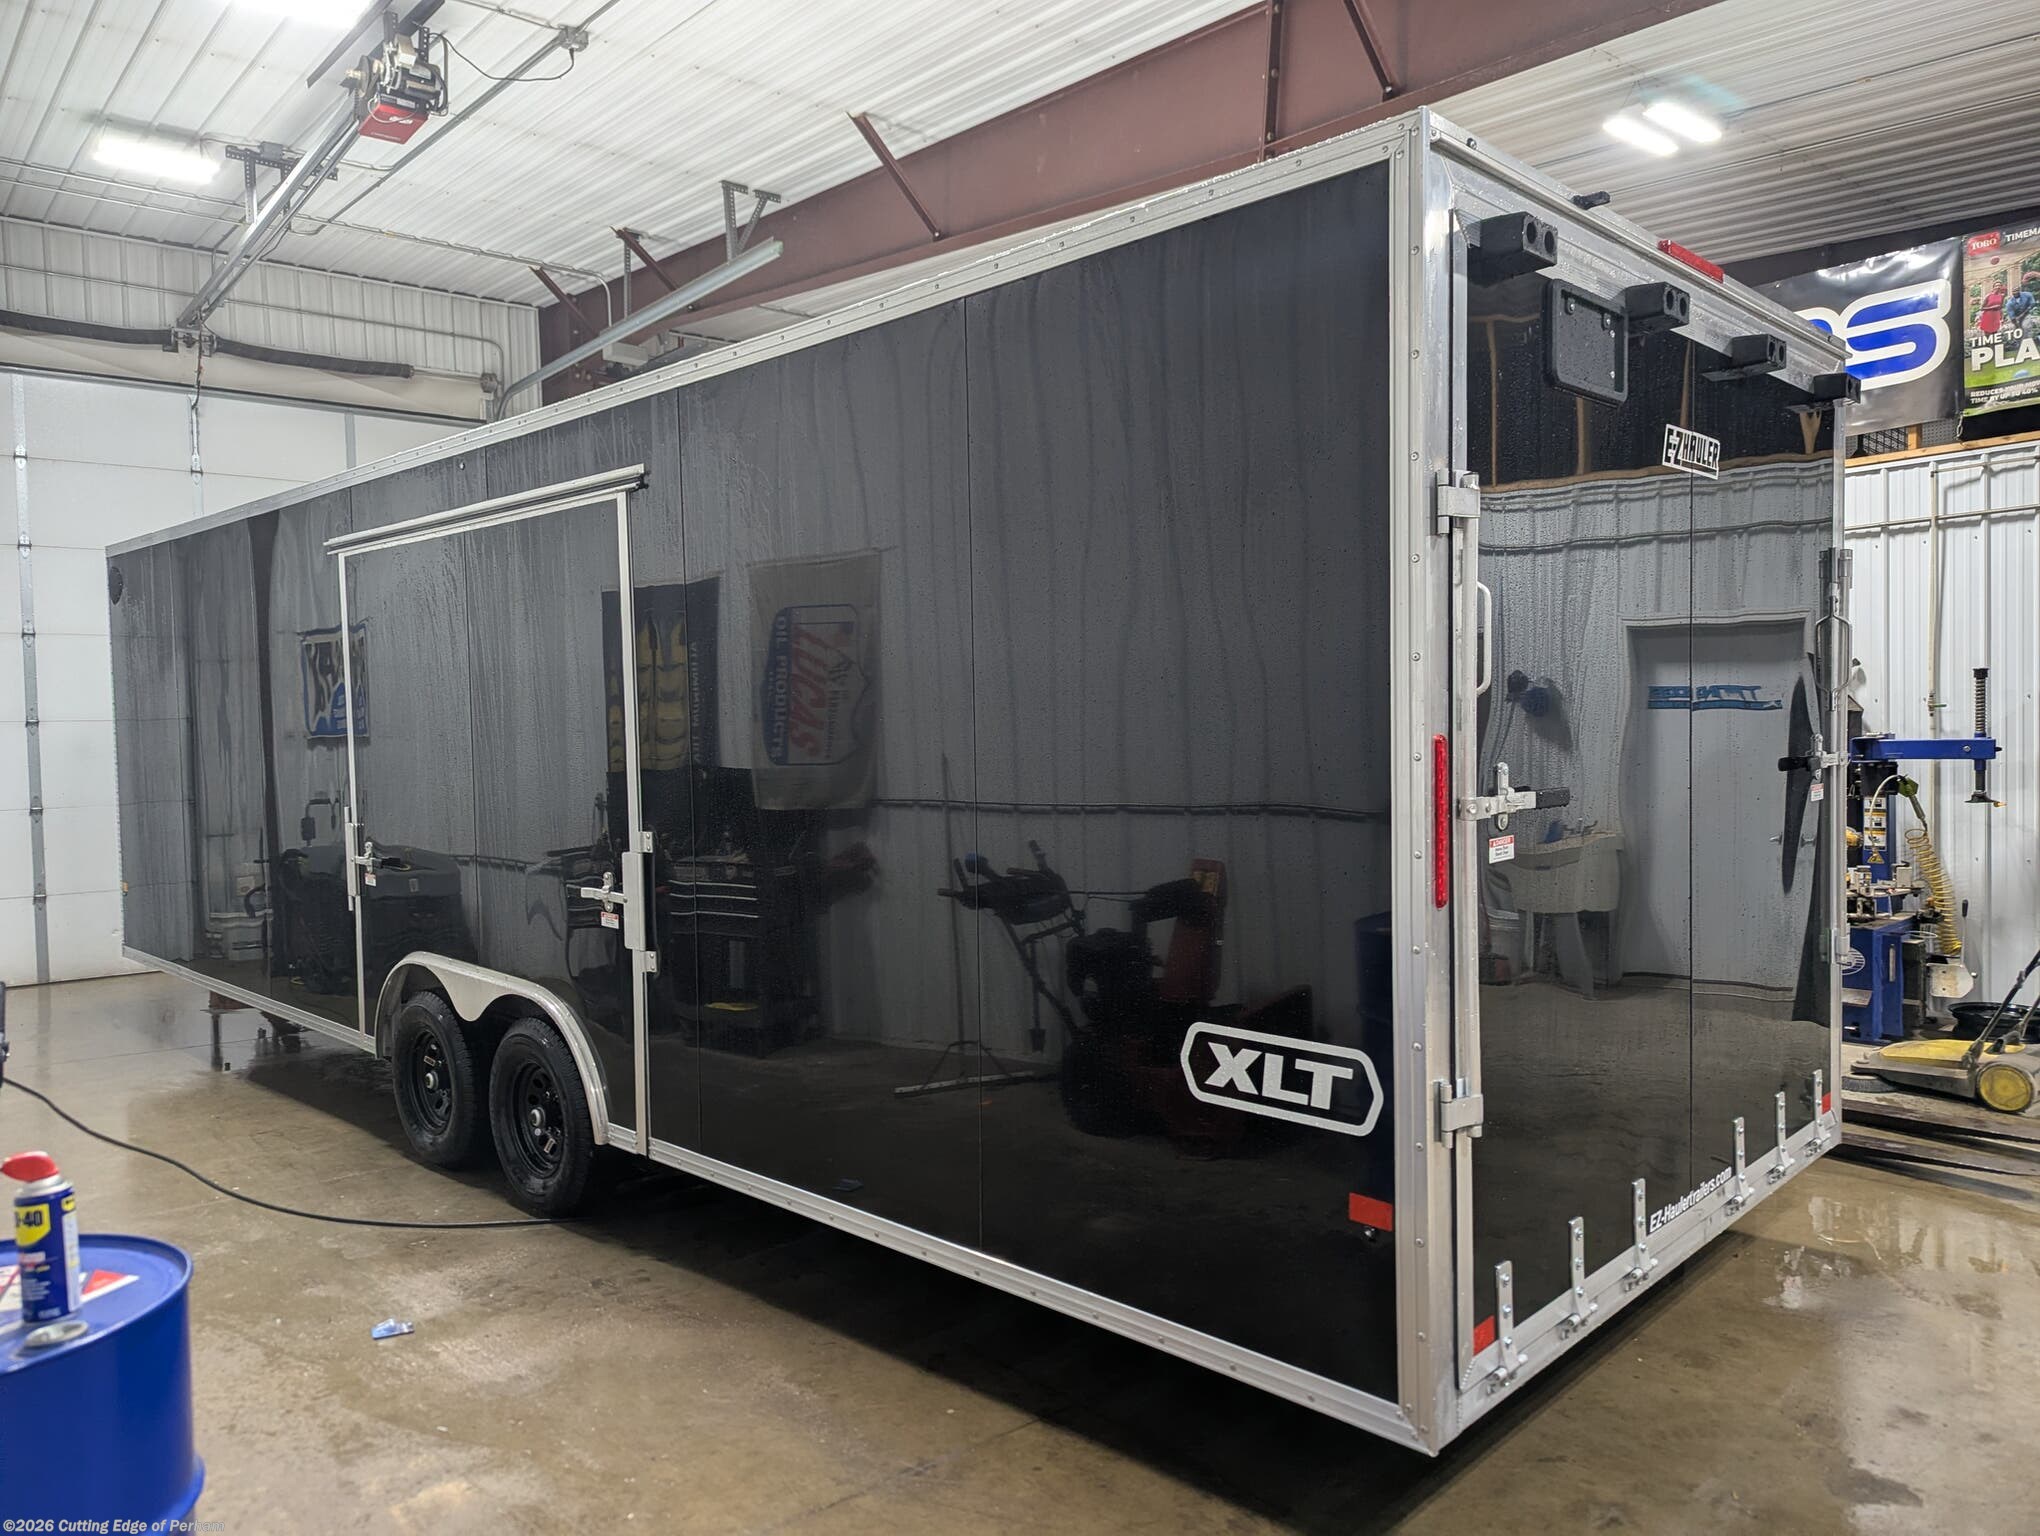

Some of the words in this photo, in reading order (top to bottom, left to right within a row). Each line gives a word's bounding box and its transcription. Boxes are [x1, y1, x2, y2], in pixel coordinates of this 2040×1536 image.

[1972, 238, 1997, 250] TORO
[1969, 332, 2002, 347] TIME
[2004, 328, 2023, 340] TO
[1972, 338, 2040, 371] PLA
[1682, 433, 1718, 469] HAULER
[1205, 1042, 1353, 1110] XLT
